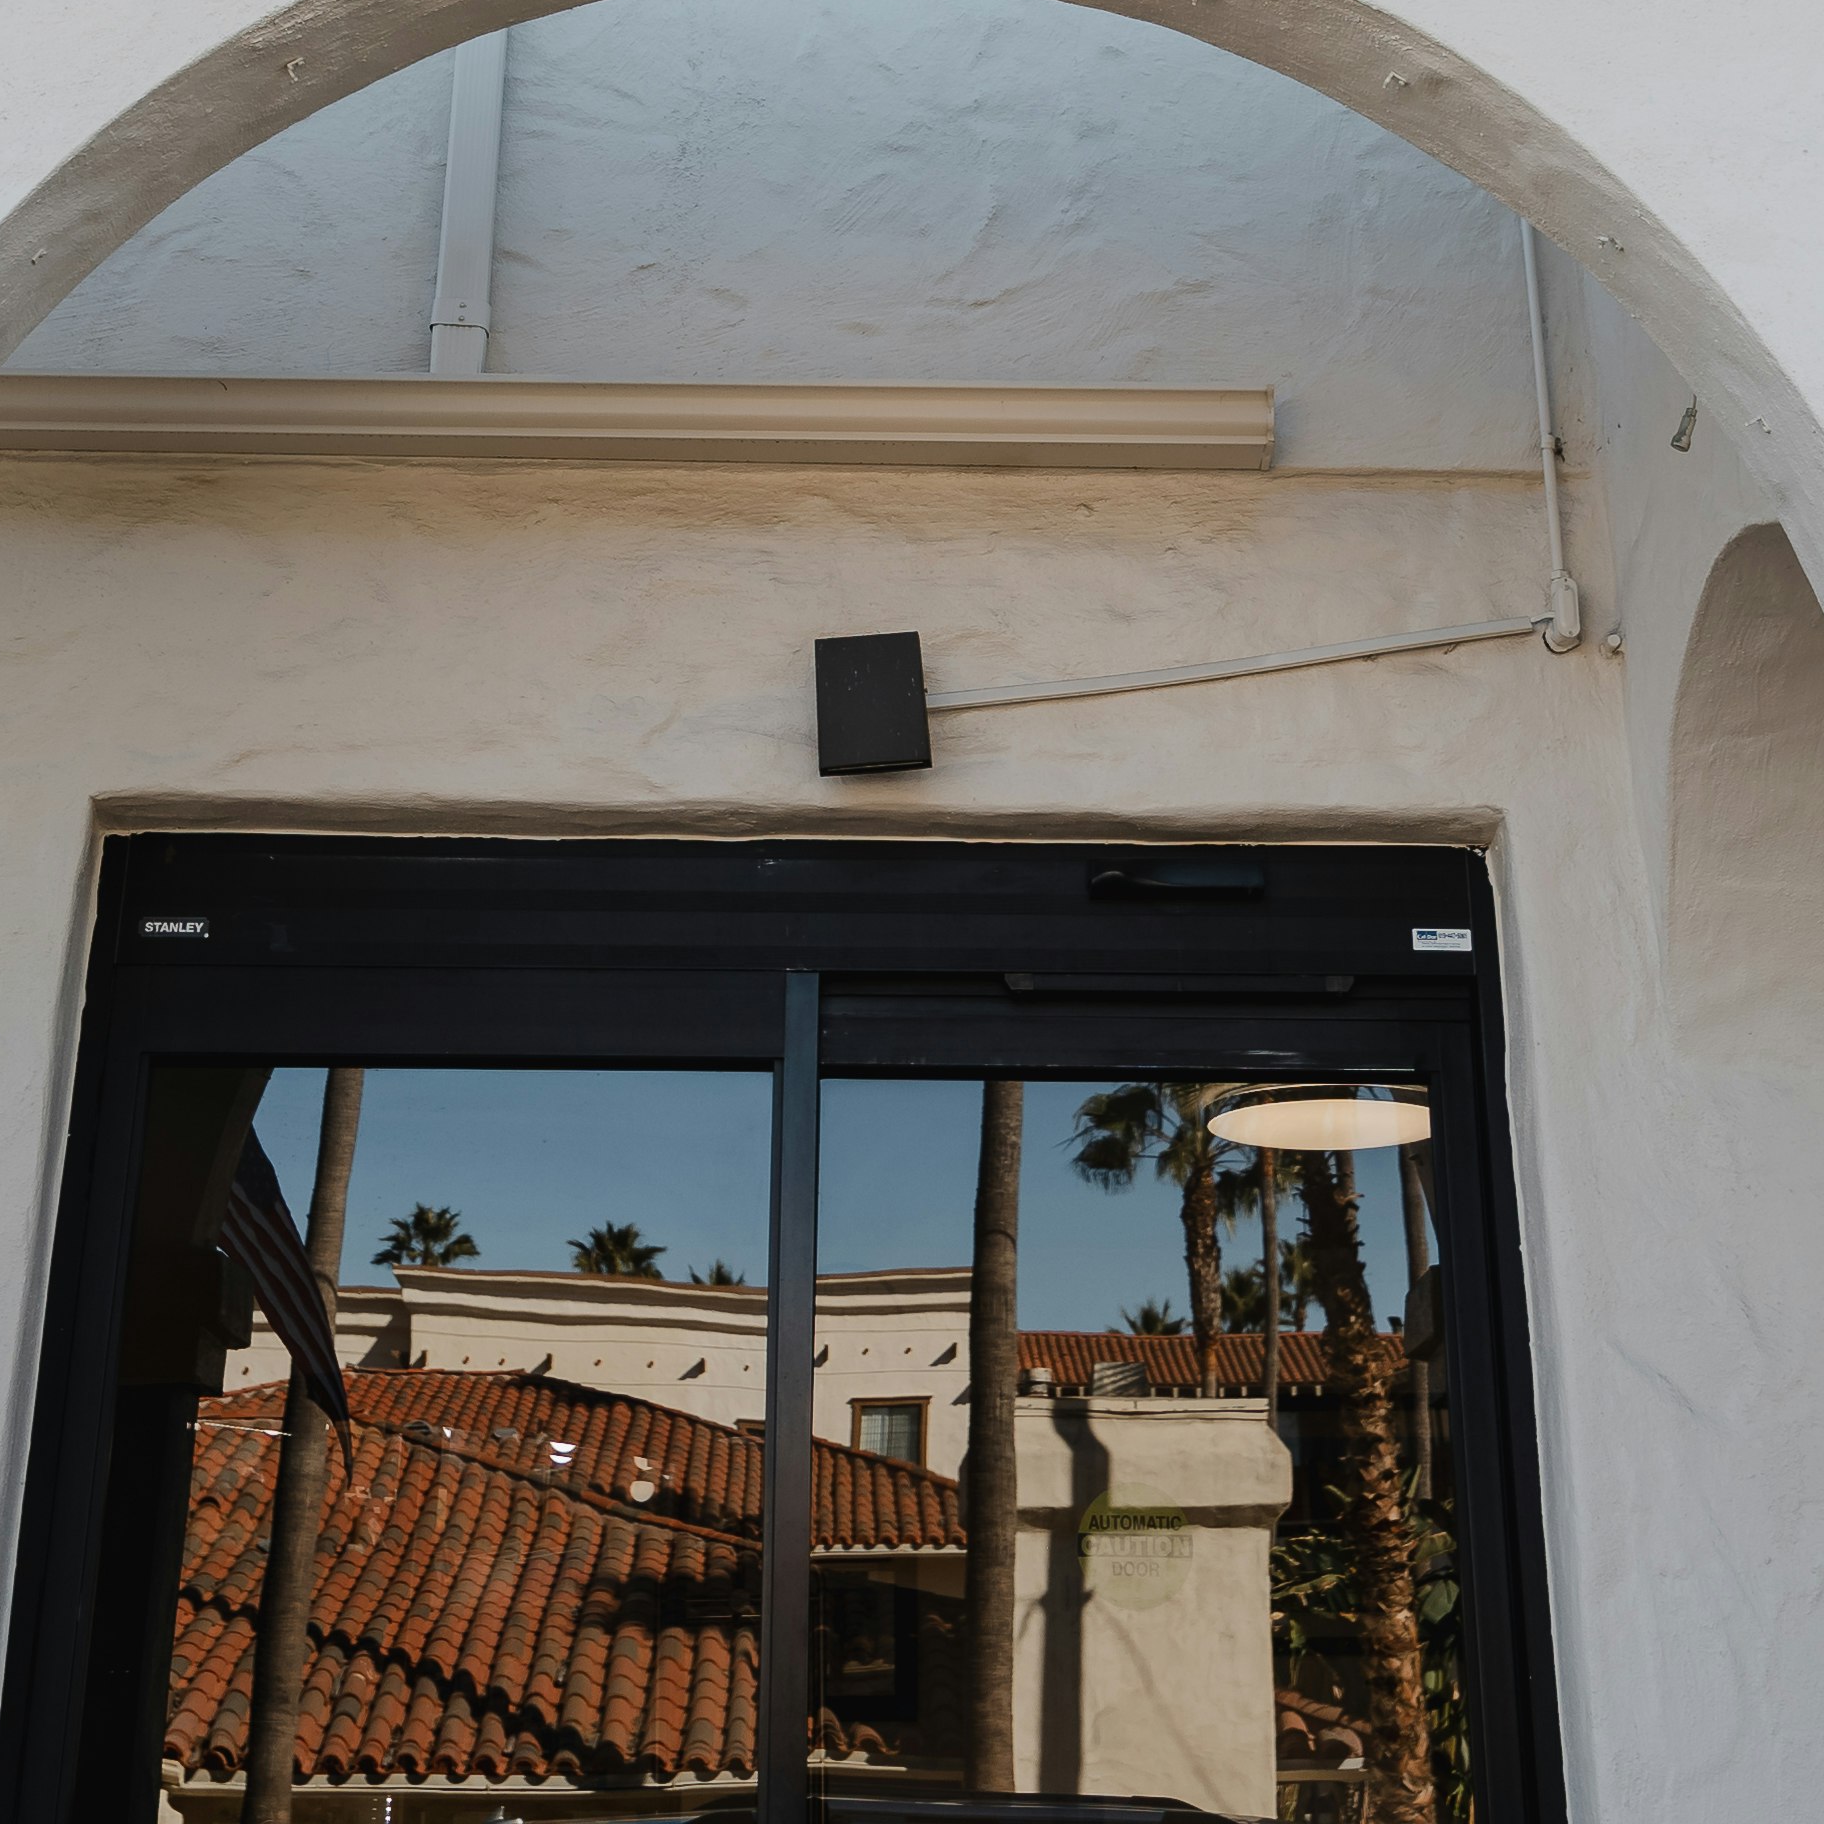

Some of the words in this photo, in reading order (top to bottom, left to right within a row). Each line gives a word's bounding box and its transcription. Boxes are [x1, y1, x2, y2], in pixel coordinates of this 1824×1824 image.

[144, 922, 204, 933] STANLEY
[1088, 1514, 1182, 1531] AUTOMATIC
[1081, 1534, 1192, 1557] CAUTION
[1112, 1561, 1160, 1577] DOOR
